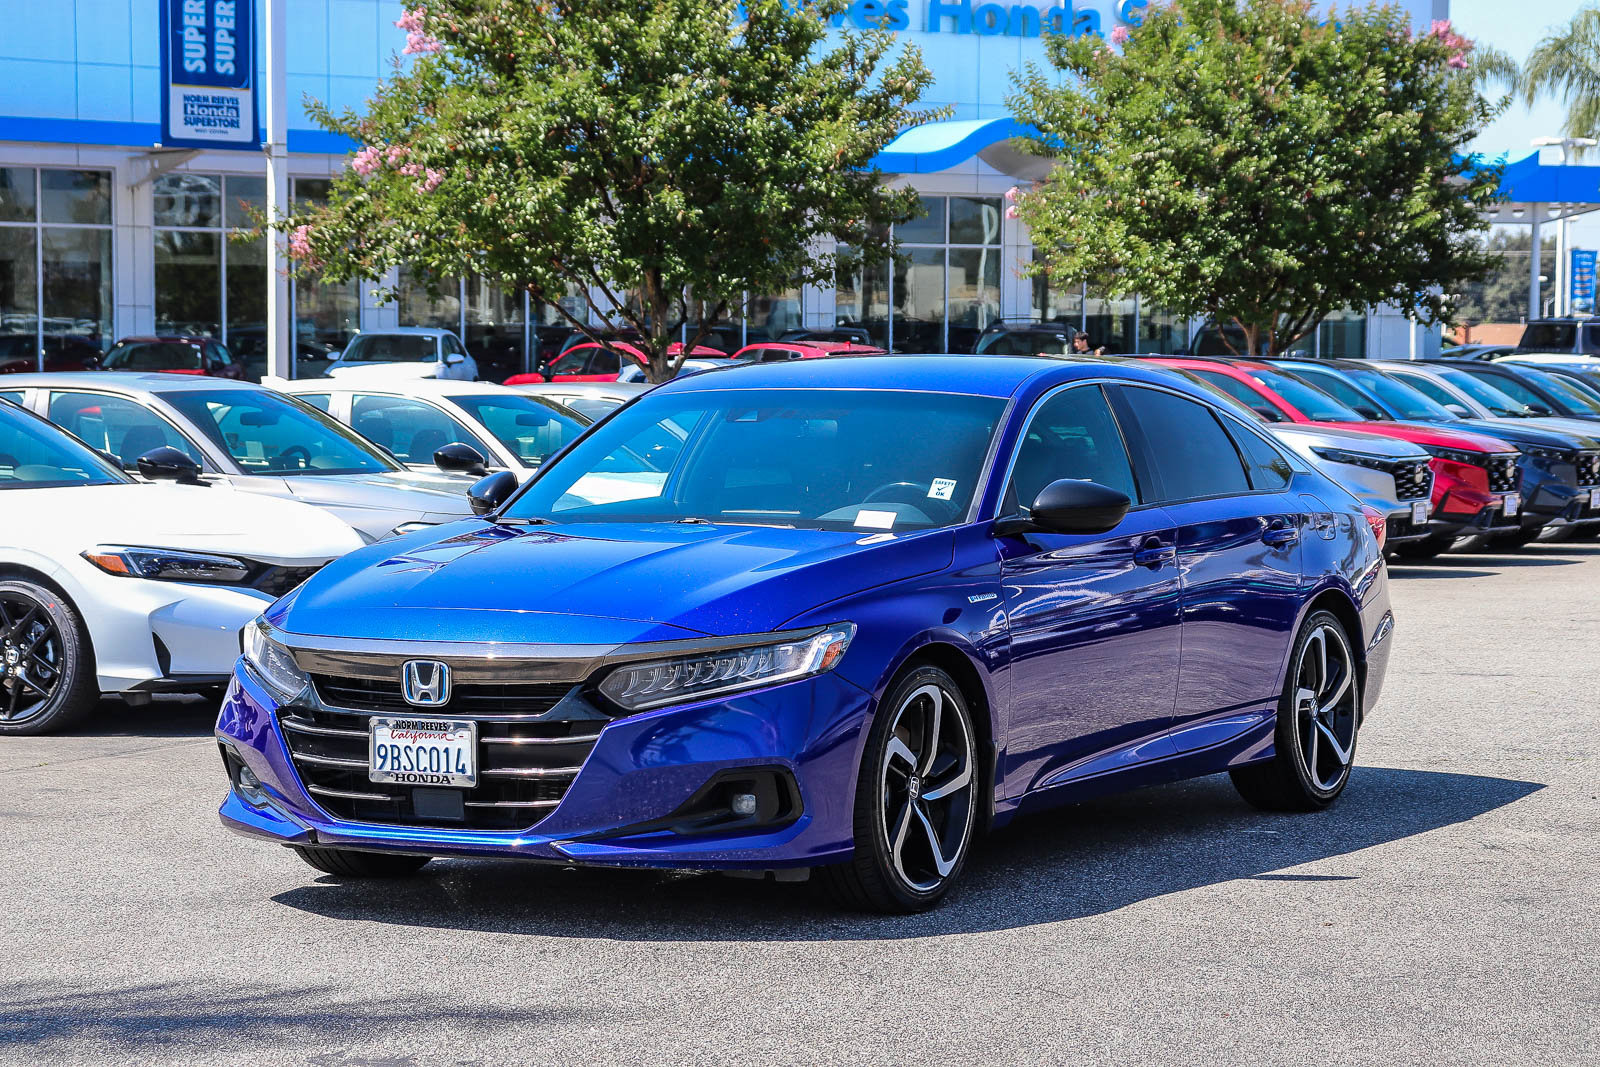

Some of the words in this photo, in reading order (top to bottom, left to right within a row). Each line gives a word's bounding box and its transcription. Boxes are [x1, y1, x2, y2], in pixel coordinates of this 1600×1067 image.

[928, 0, 1104, 38] Honda
[183, 0, 206, 73] SUPER
[214, 0, 236, 75] SUPER
[183, 94, 209, 103] NORM
[211, 95, 240, 105] REEVES
[186, 103, 238, 117] Honda
[183, 116, 240, 129] SUPERSTORE
[395, 719, 418, 730] NORM
[421, 720, 449, 732] REEVES
[390, 729, 455, 744] California
[377, 743, 467, 775] 9BSC014
[394, 772, 452, 785] HONDA
